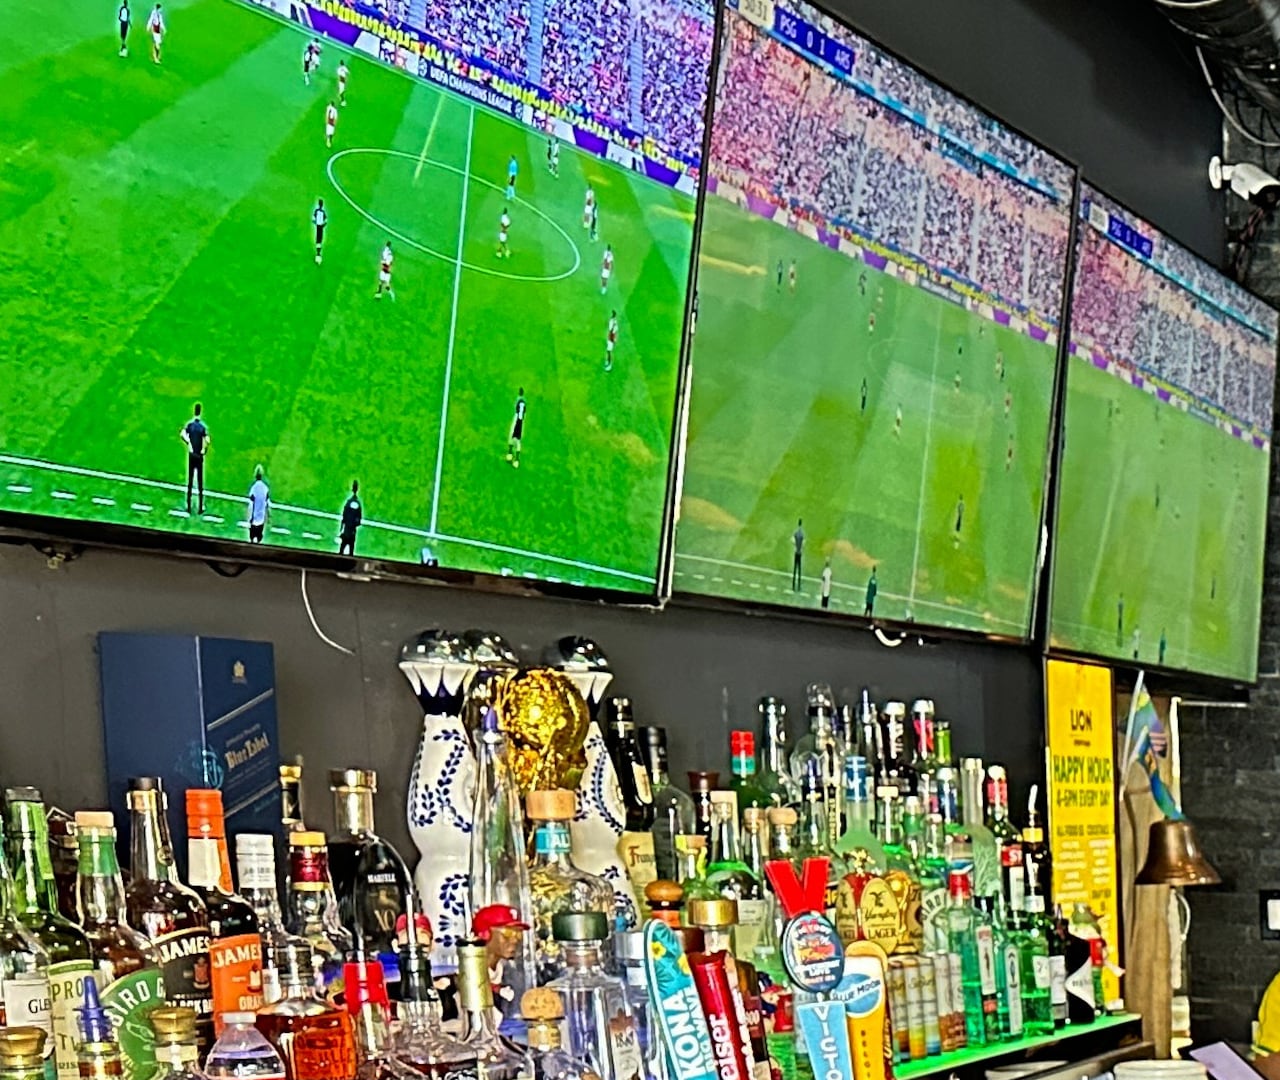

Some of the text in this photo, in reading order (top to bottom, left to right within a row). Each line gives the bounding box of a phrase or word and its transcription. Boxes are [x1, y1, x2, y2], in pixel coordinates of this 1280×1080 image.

[779, 15, 798, 39] PSG
[806, 31, 813, 48] 0
[820, 39, 826, 55] 1
[834, 49, 850, 70] ARS
[430, 65, 513, 114] UEFA CHAMPIONS LEAGUE
[1070, 708, 1093, 732] LION
[246, 732, 270, 758] Label
[1053, 754, 1112, 785] HAPPY HOUR
[867, 927, 898, 939] LAGER
[856, 977, 882, 996] MOON
[663, 993, 700, 1080] KONA
